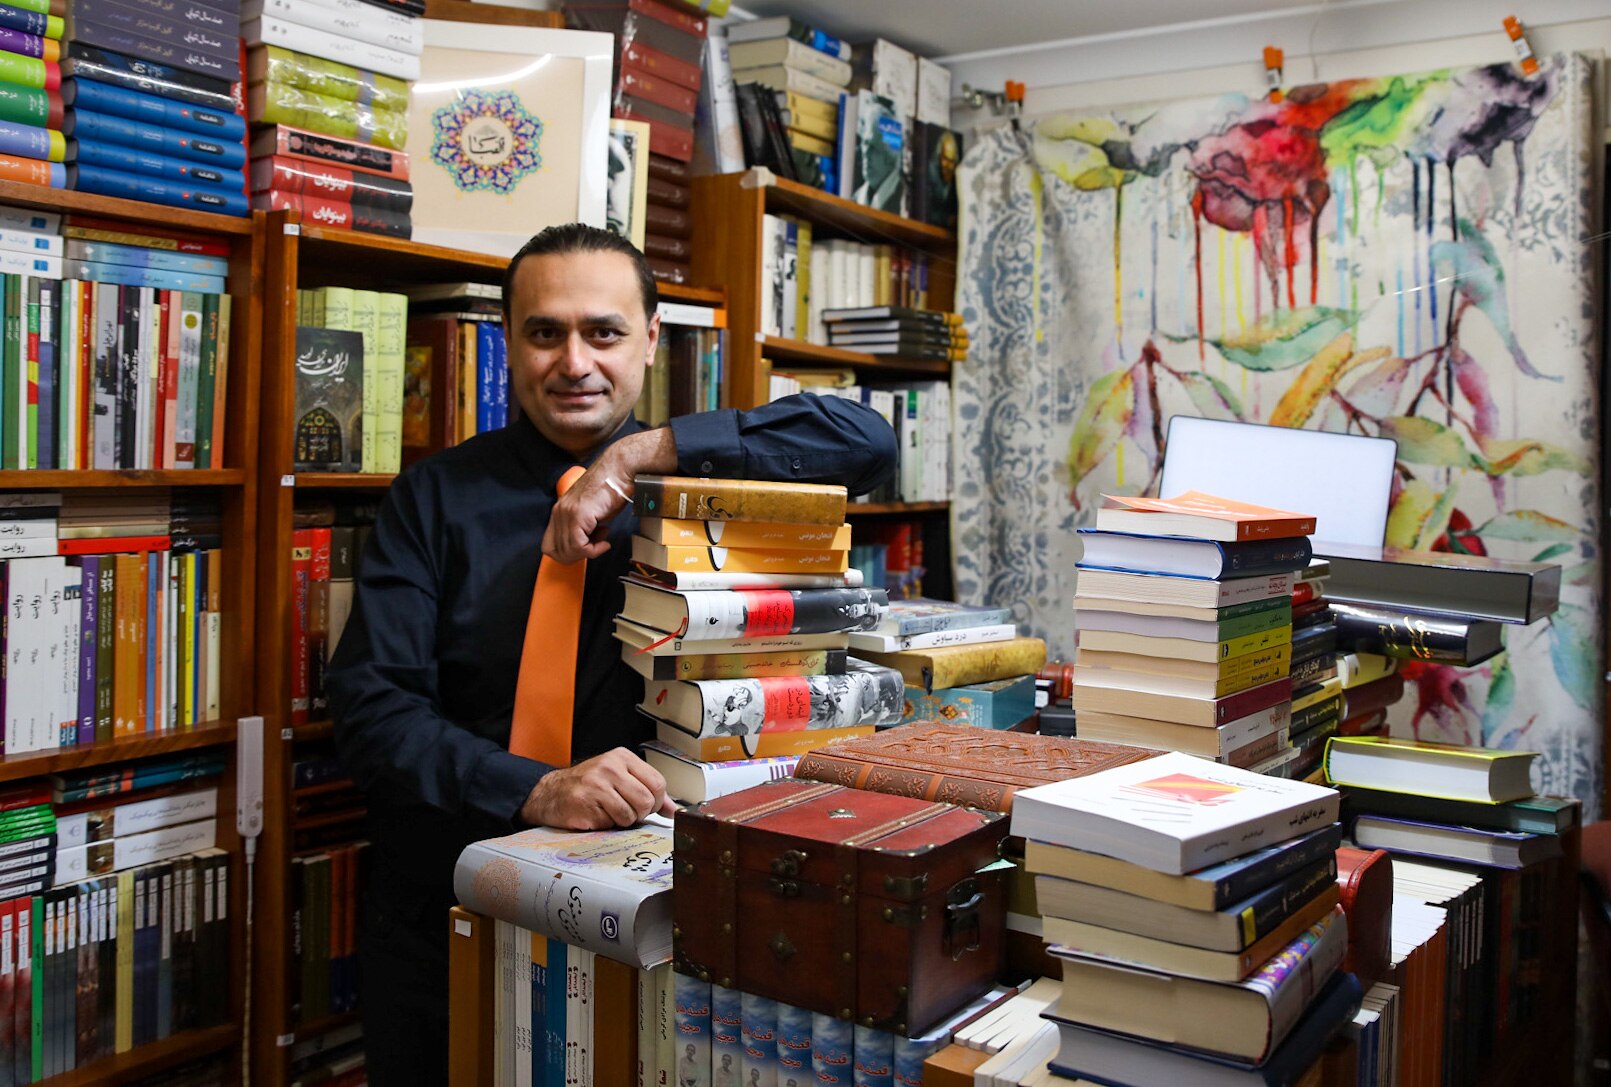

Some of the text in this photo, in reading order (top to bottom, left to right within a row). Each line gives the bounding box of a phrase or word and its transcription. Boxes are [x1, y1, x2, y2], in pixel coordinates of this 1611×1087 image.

[313, 206, 347, 225] بینوایان
[1, 524, 24, 535] روایت
[2, 543, 26, 553] روایت
[12, 594, 23, 619] روایت
[30, 594, 41, 619] روایت
[50, 590, 61, 615] روایت
[679, 1024, 701, 1034] مجید
[716, 1034, 737, 1044] مجید
[745, 1046, 766, 1058] مجید
[779, 1056, 802, 1068] مجید
[815, 1070, 839, 1083] مجید
